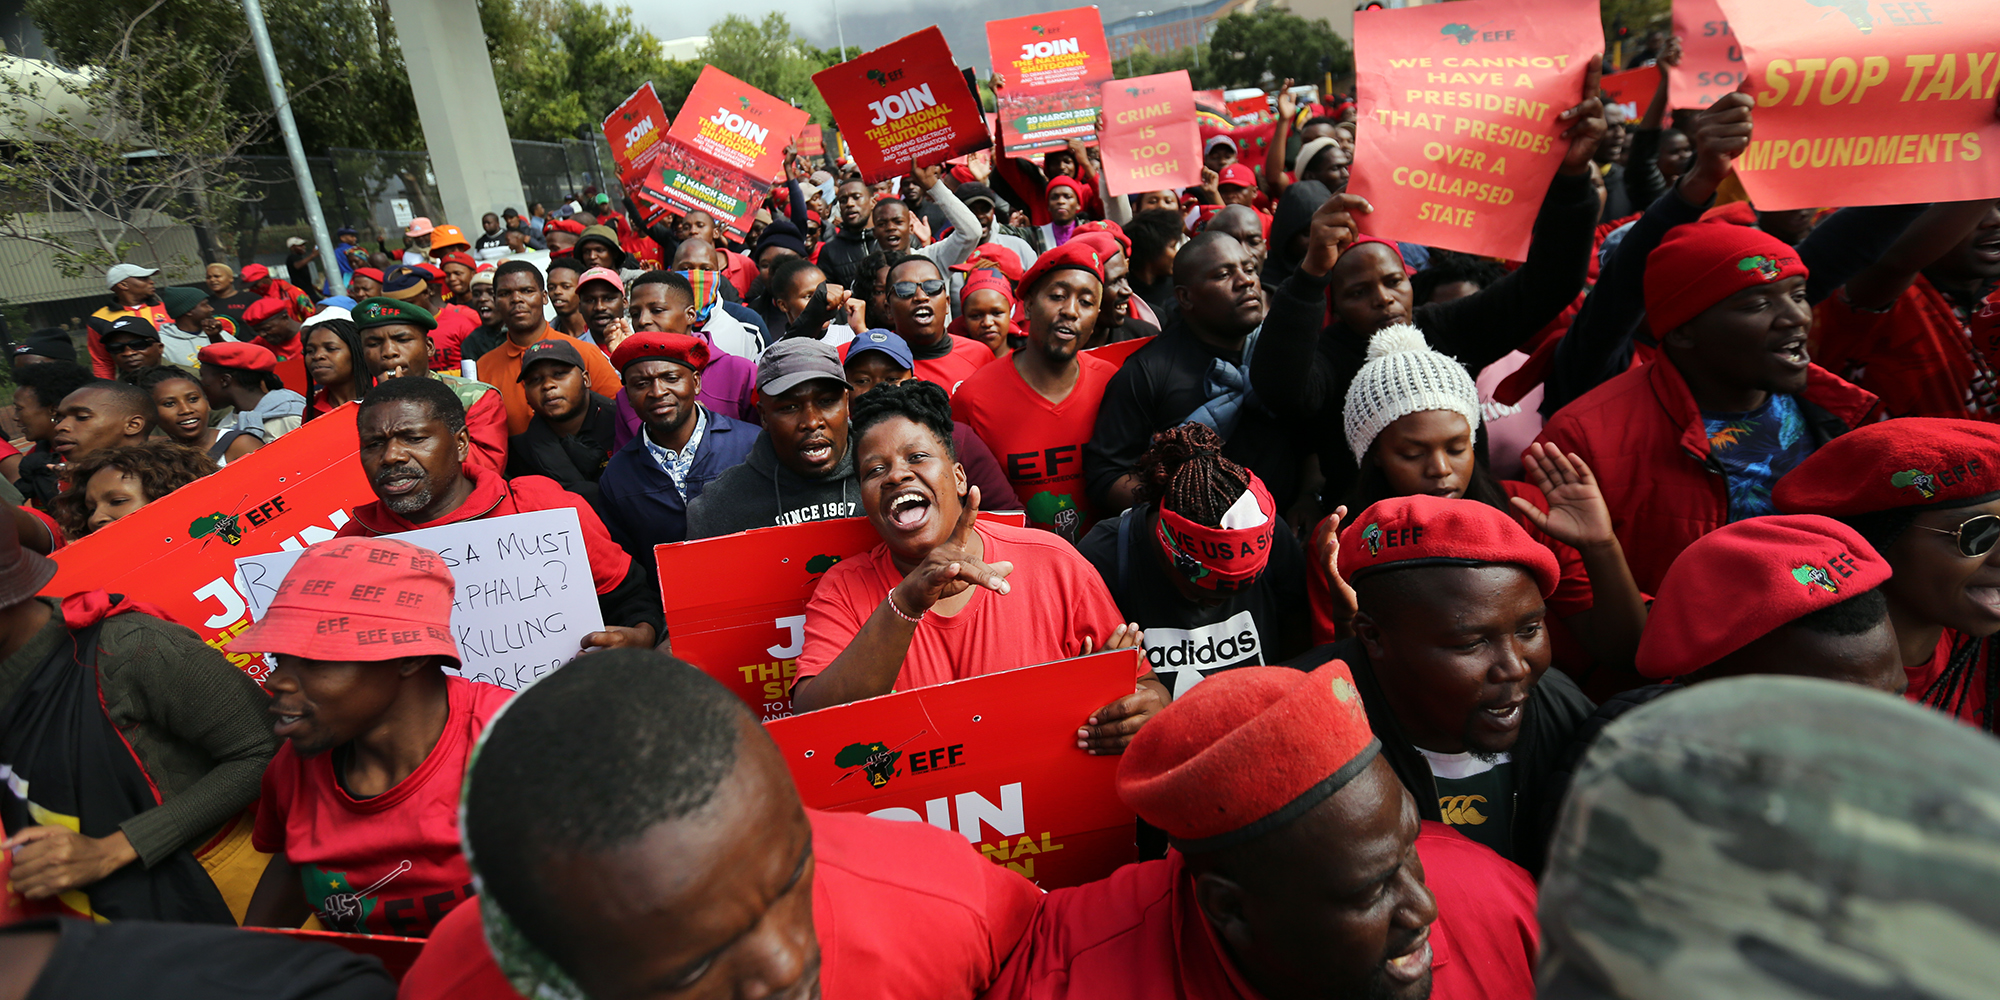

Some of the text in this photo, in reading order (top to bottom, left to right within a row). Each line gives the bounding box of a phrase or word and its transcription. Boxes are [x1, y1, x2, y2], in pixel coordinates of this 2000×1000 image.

[1880, 2, 1933, 22] EFF
[1482, 30, 1516, 42] EFF
[1012, 51, 1090, 68] THE NATIONAL
[1020, 37, 1080, 60] JOIN
[1021, 59, 1084, 74] SHUTDOWN
[1389, 54, 1570, 68] WE CANNOT
[888, 68, 904, 81] EFF
[1427, 72, 1534, 89] HAVE A
[1757, 56, 1890, 108] STOP
[868, 82, 936, 126] JOIN
[1116, 102, 1172, 124] CRIME
[1406, 90, 1550, 122] PRESIDENT
[710, 106, 769, 145] JOIN
[865, 103, 953, 140] THE NATIONAL
[1026, 116, 1038, 124] 20
[1039, 112, 1073, 121] MARCH
[1038, 119, 1076, 128] FREEDOM
[625, 115, 654, 148] JOIN
[698, 116, 767, 156] THE NATIONAL
[700, 127, 759, 159] SHUTDOWN
[878, 116, 948, 148] SHUTDOWN
[890, 139, 916, 152] DEMAND
[916, 126, 952, 143] ELECTRICITY
[1139, 124, 1156, 139] IS
[1376, 109, 1554, 154] THAT PRESIDES
[884, 154, 896, 162] AND
[908, 135, 947, 153] RESIGNATION
[947, 132, 956, 140] OF
[1130, 142, 1171, 161] TOO
[1424, 142, 1506, 175] OVER A
[895, 155, 912, 164] CYRIL
[1130, 159, 1179, 179] HIGH
[672, 180, 681, 188] IS
[682, 183, 716, 204] FREEDOM
[716, 200, 735, 212] DAY!
[675, 173, 737, 207] 20 MARCH 2023
[1392, 166, 1515, 206] COLLAPSED
[663, 186, 736, 223] #NATIONALSHUTDOWN
[1418, 202, 1476, 228] STATE
[381, 308, 401, 316] EFF
[1938, 460, 1980, 487] EFF
[245, 496, 285, 527] EFF
[775, 504, 820, 526] SINCE
[497, 530, 570, 560] MUST
[1386, 526, 1424, 547] EFF
[369, 548, 399, 563] EFF
[1201, 540, 1234, 560] US
[1241, 542, 1255, 558] A
[411, 557, 435, 571] EFF
[1828, 552, 1859, 578] EF
[302, 580, 336, 592] EFF
[351, 584, 387, 599] EFF
[396, 591, 424, 606] EFF
[317, 617, 349, 634] EFF
[356, 629, 387, 643] EFF
[391, 630, 420, 643] EFF
[458, 612, 567, 662] KILLING
[1147, 630, 1256, 668] adidas
[738, 659, 797, 683] THE
[763, 702, 783, 712] TO
[909, 744, 963, 772] EFF
[866, 782, 1025, 844] IN
[385, 881, 476, 938] EF
